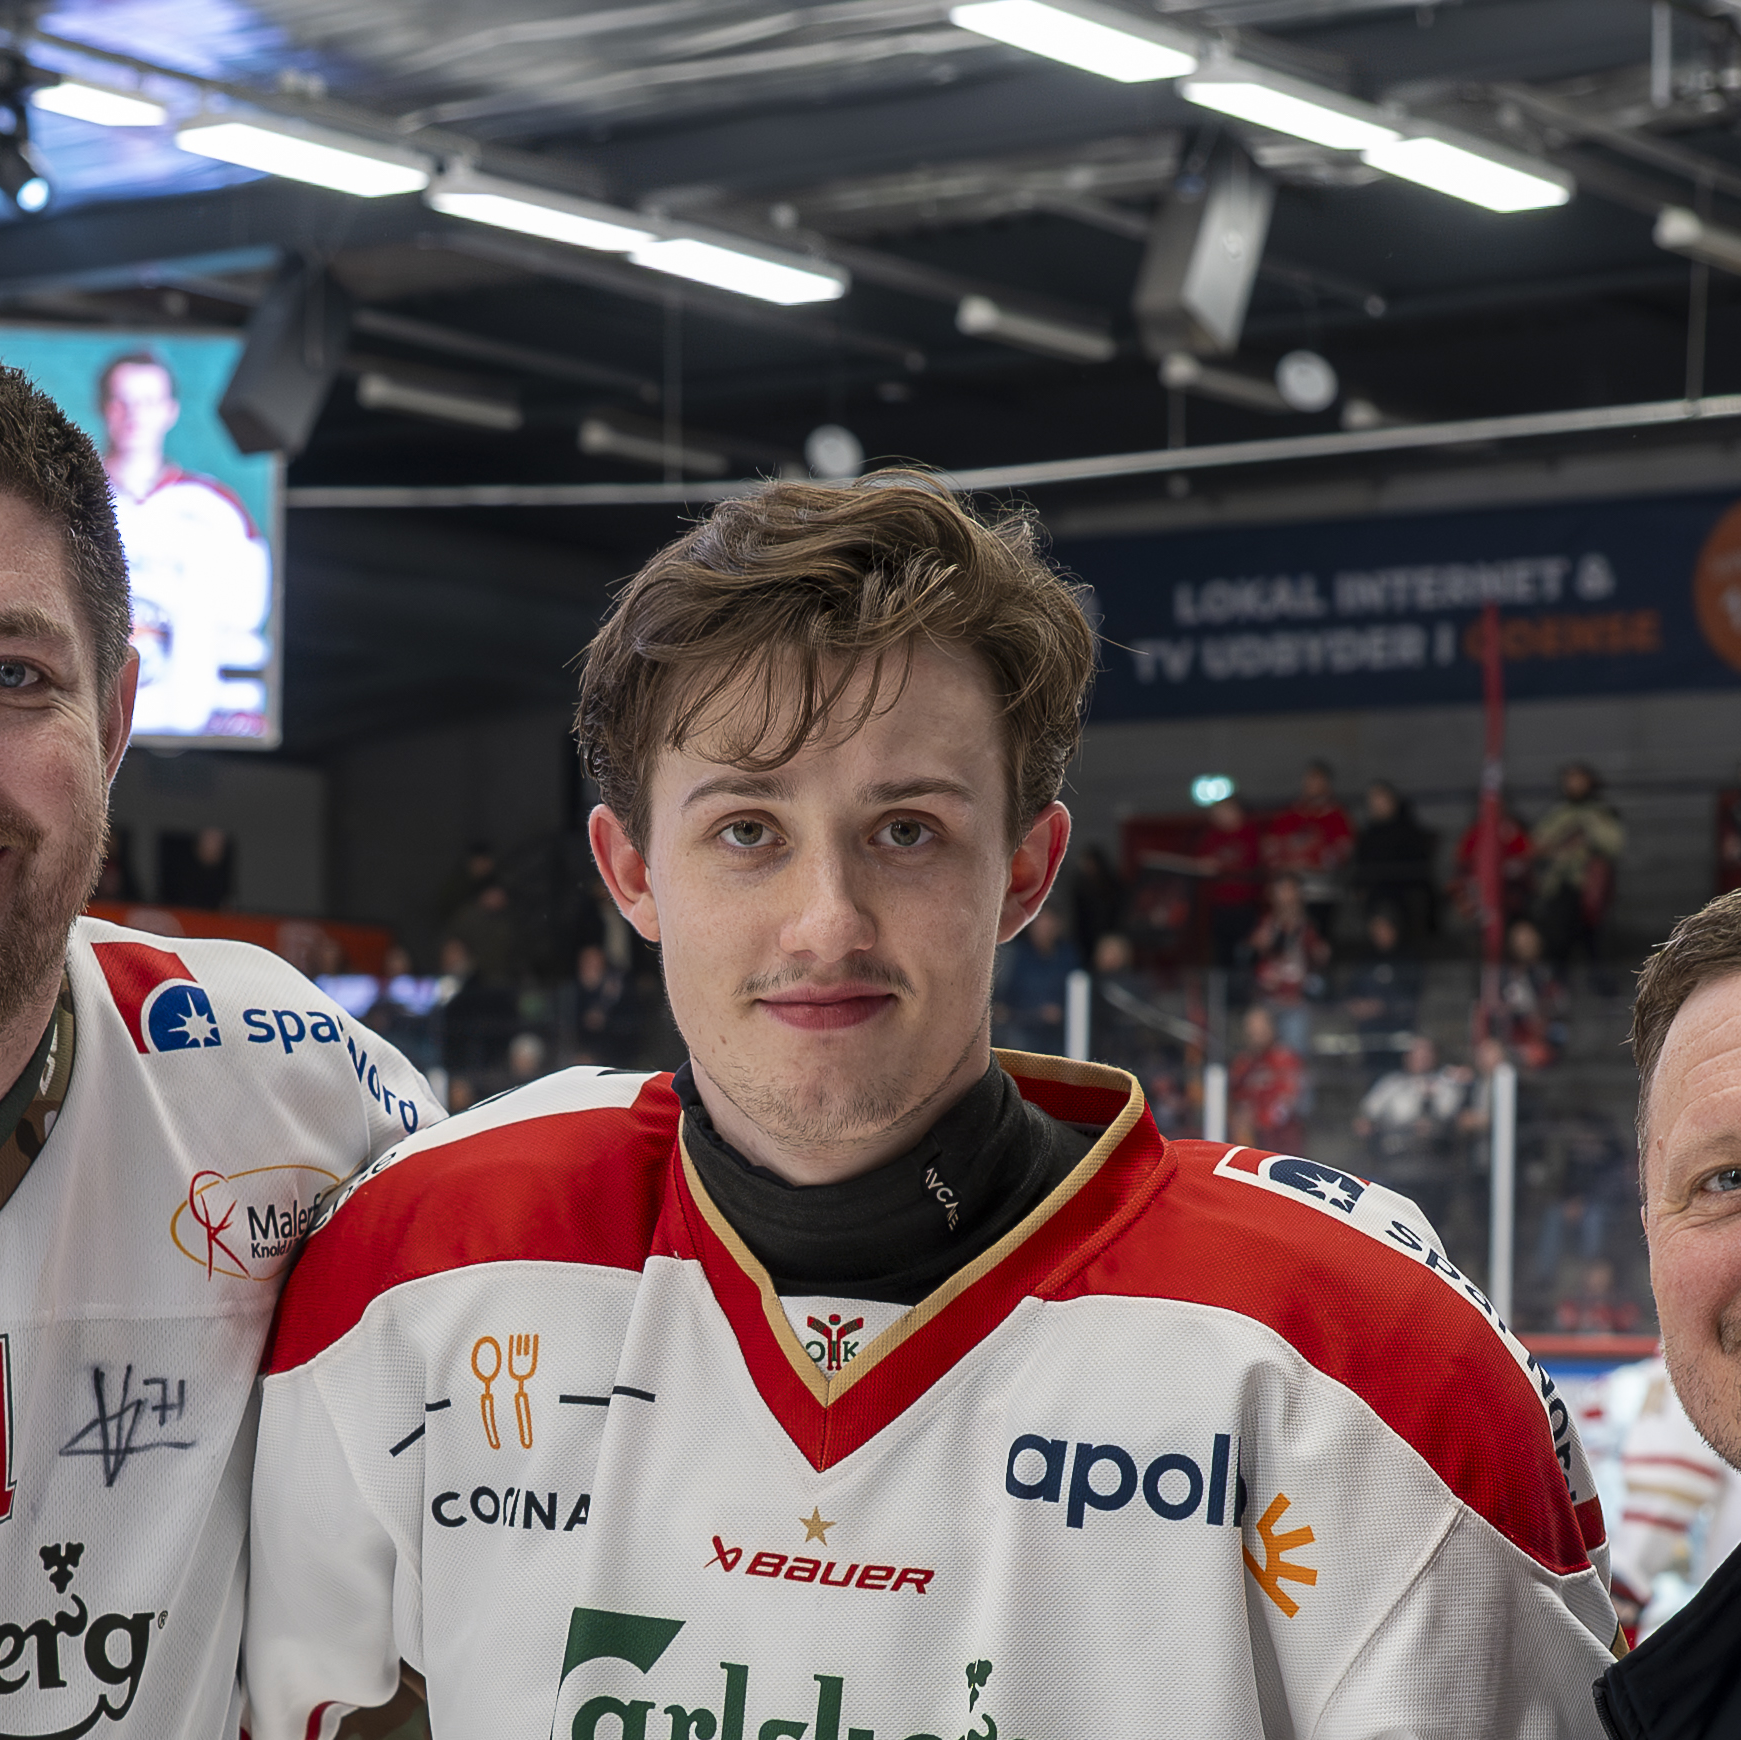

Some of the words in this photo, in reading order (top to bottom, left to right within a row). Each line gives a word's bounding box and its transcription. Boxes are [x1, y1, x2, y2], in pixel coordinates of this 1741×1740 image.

[1173, 570, 1323, 626] LOKAL
[1334, 556, 1571, 616] INTERNET
[1131, 637, 1193, 684] TV
[1203, 622, 1429, 678] UDBYDER
[242, 1006, 346, 1055] spa
